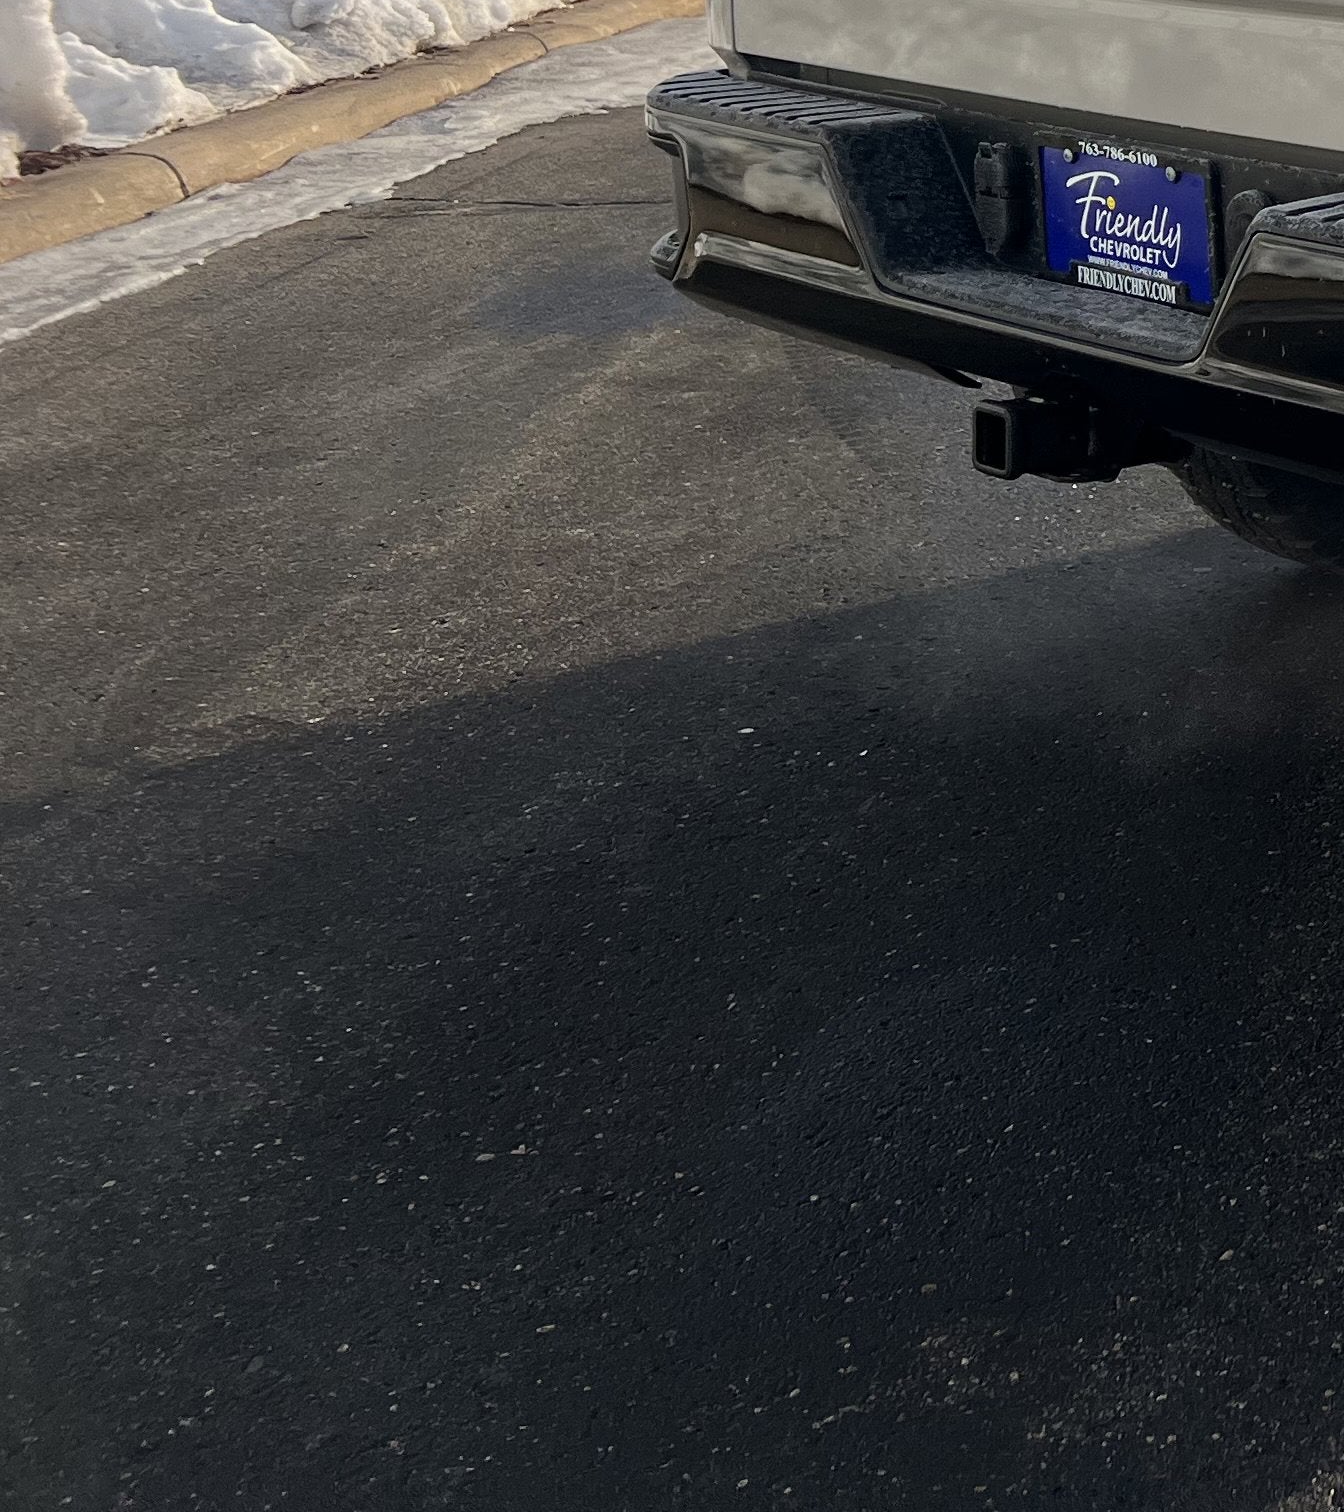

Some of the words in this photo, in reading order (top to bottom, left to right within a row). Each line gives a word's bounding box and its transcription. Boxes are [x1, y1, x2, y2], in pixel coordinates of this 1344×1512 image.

[1078, 141, 1158, 167] 763-786-6100
[1066, 171, 1181, 269] Friendly
[1089, 236, 1162, 265] CHEVROLET
[1077, 265, 1176, 305] FRIENDLYCHEV.COM
